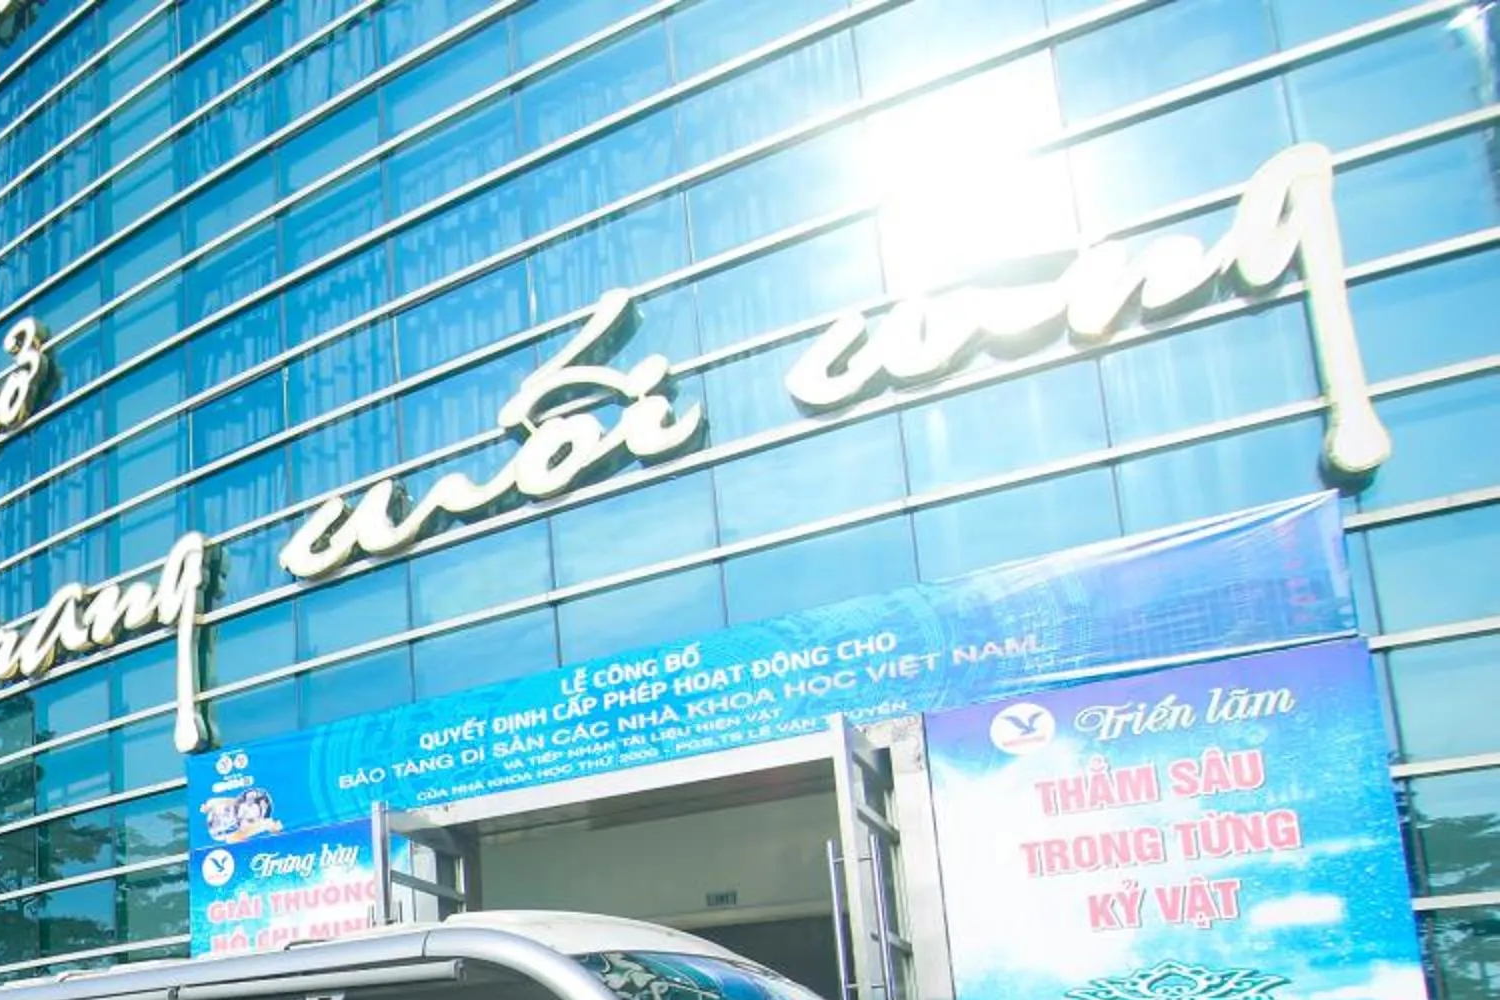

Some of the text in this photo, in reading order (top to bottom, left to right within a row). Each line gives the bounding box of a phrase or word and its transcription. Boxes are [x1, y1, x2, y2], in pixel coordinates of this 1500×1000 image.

[279, 287, 702, 578] cuối
[419, 631, 898, 751] QUYẾT ĐỊNH CẤP PHÉP HOẠT ĐỘNG CHO
[561, 641, 701, 696] LỄ CÔNG BỐ
[338, 766, 387, 789] BẢO
[392, 753, 456, 777] TÀNG
[493, 730, 545, 758] SẢN
[552, 719, 611, 746] CÁC
[617, 704, 680, 732] NHÀ
[687, 687, 777, 718] KHOA
[783, 670, 858, 698] HỌC
[865, 651, 942, 683] VIỆT
[952, 632, 1038, 666] NAM
[1206, 687, 1295, 724] lãm
[1169, 749, 1263, 796] SÂU
[1019, 810, 1299, 875] TRONG TỪNG
[1088, 876, 1240, 929] KỶ VẬT
